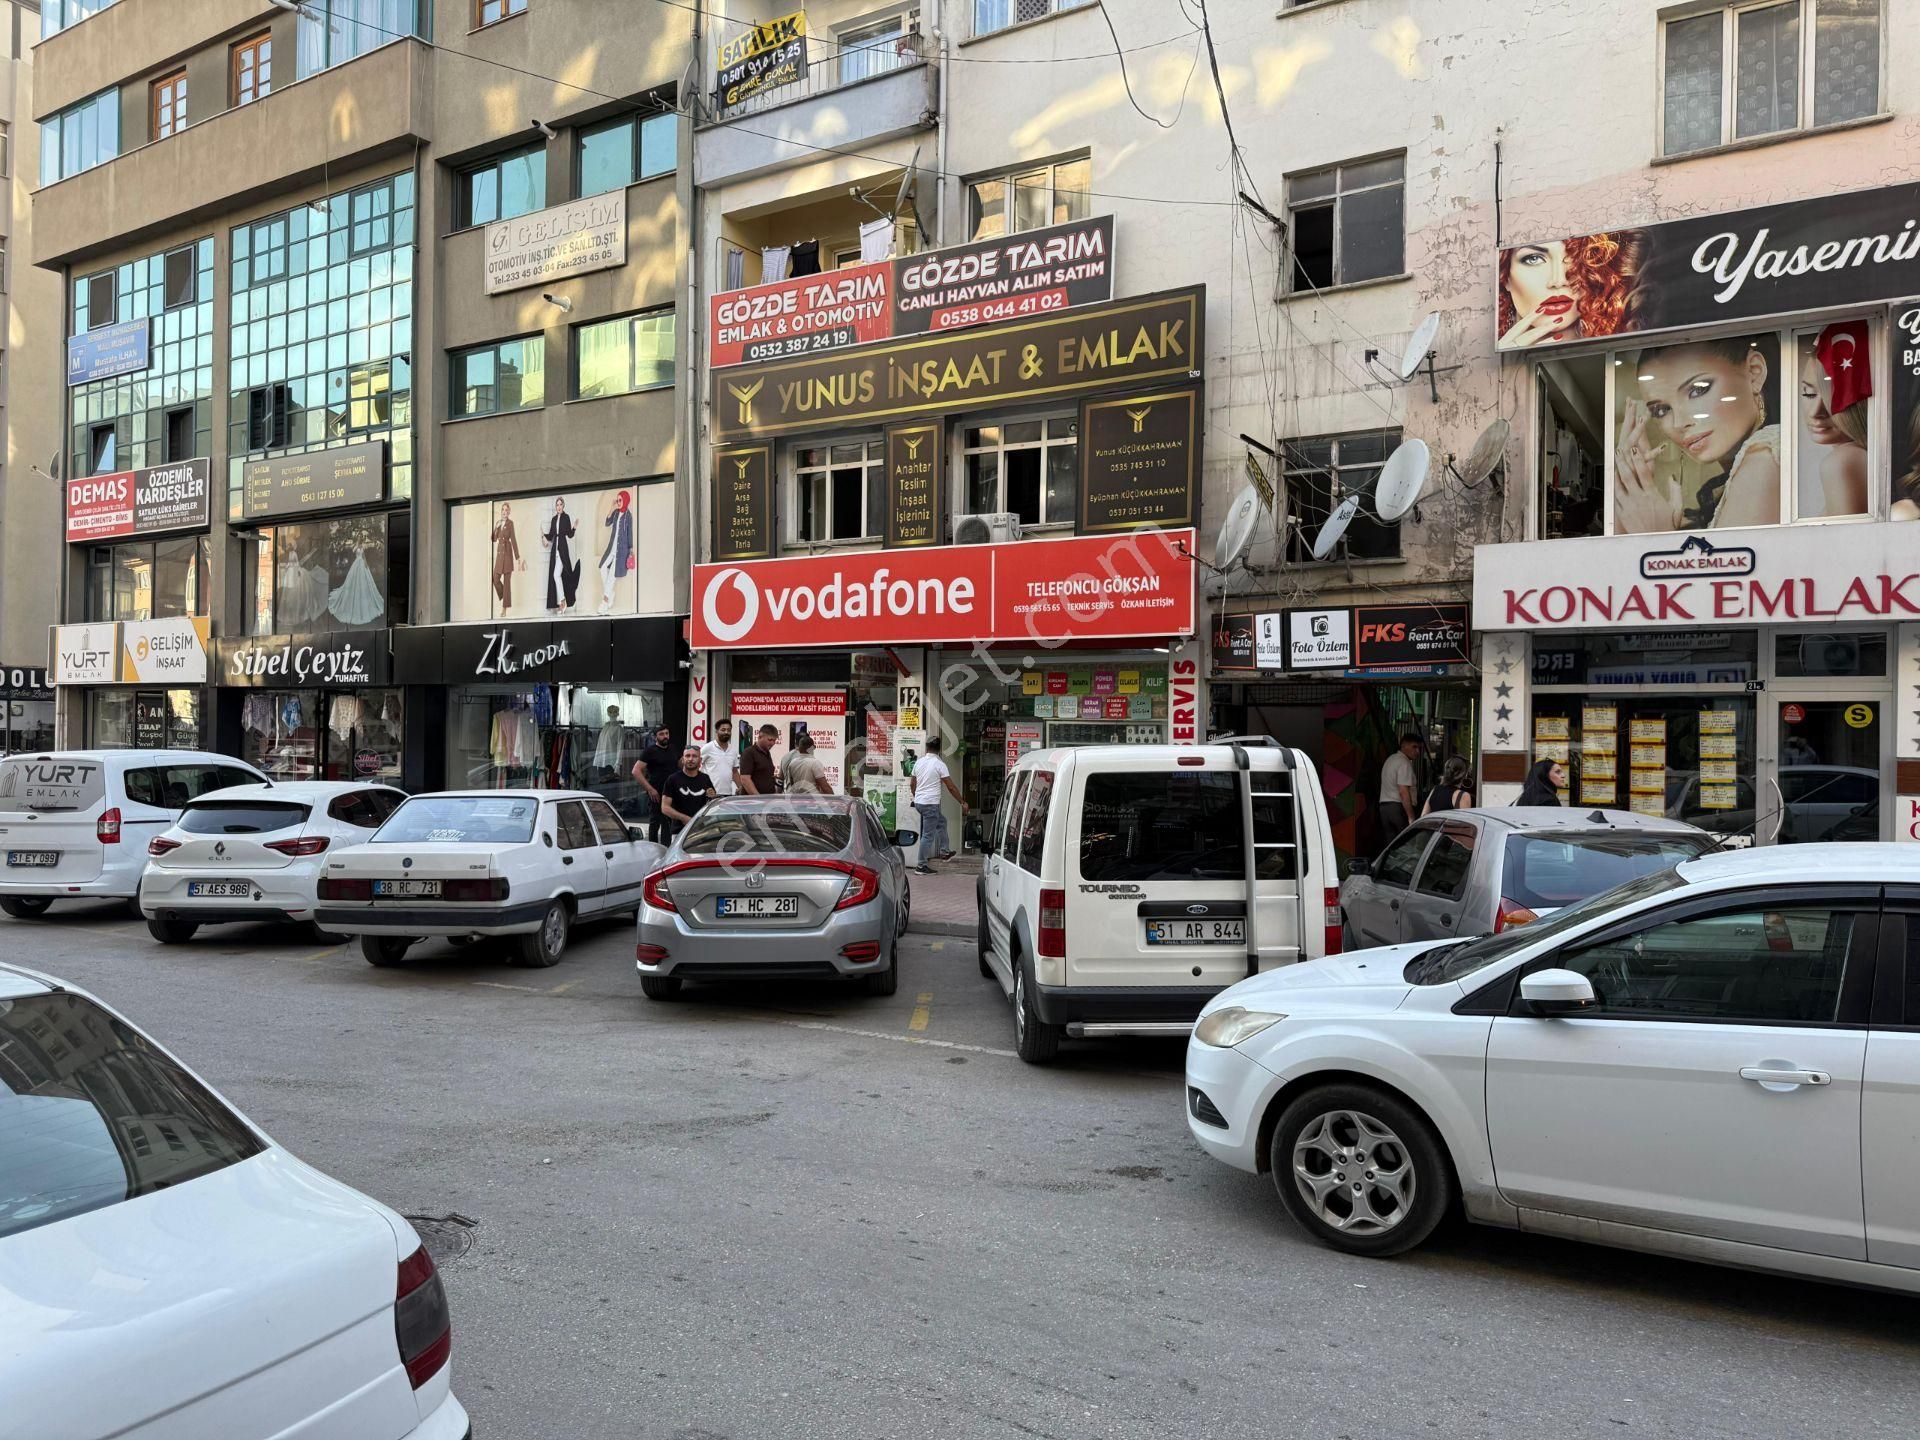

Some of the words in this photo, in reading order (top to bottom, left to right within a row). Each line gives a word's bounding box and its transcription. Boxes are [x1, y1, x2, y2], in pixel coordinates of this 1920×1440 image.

[721, 15, 798, 67] SATILIK
[721, 74, 728, 87] 0
[729, 65, 746, 83] 507
[787, 42, 801, 59] 25
[739, 73, 763, 93] EMRE
[517, 200, 619, 248] GELİŞİM
[488, 252, 528, 274] OTOMOTİV
[521, 268, 532, 280] 45
[588, 252, 600, 263] 45
[601, 249, 612, 260] 05
[902, 249, 997, 292] GÖZDE
[1004, 228, 1105, 270] TARIM
[900, 291, 944, 313] CANLI
[946, 279, 1009, 307] HAYVAN
[1011, 271, 1052, 292] ALIM
[1054, 259, 1105, 286] SATIM
[717, 287, 799, 326] GÖZDE
[801, 271, 886, 317] TARIM
[940, 307, 978, 327] 0538
[982, 302, 1015, 321] 044
[1018, 297, 1037, 313] 41
[1040, 292, 1063, 310] 02
[717, 317, 773, 346] EMLAK
[775, 318, 788, 335] &
[791, 299, 884, 331] OTOMOTİV
[749, 341, 782, 359] 0532
[785, 337, 810, 353] 387
[812, 334, 831, 350] 24
[832, 331, 848, 346] 19
[777, 369, 875, 415] YUNUS
[886, 348, 1007, 400] İNŞAAT
[1018, 343, 1043, 380] &
[1057, 319, 1185, 377] EMLAK
[895, 462, 932, 475] Anahtar
[1110, 463, 1128, 472] 0535
[1145, 460, 1154, 469] 51
[1156, 458, 1166, 468] 10
[149, 465, 193, 488] ÖZDEMİR
[900, 478, 927, 491] Teslim
[71, 478, 128, 506] DEMAŞ
[136, 479, 204, 505] KARDEŞLER
[336, 488, 345, 498] 00
[733, 482, 751, 491] Daire
[734, 493, 751, 502] Arsa
[899, 492, 927, 507] İnşaat
[736, 503, 749, 515] Bağ
[896, 507, 930, 524] İşleriniz
[899, 525, 927, 538] Yapılır
[1647, 558, 1696, 571] KONAK
[1698, 556, 1748, 570] EMLAK
[766, 568, 975, 621] vodafone
[1027, 579, 1100, 597] TELEFONCU
[1103, 574, 1160, 594] GÖKŞAN
[1042, 603, 1051, 612] 65
[1051, 603, 1061, 612] 65
[1067, 601, 1090, 611] TEKNİK
[1091, 600, 1114, 611] SERVİS
[1121, 599, 1145, 609] ÖZKAN
[1145, 597, 1174, 608] İLETİŞİM
[1503, 583, 1696, 624] KONAK
[1710, 574, 1920, 619] EMLAK
[1214, 630, 1230, 648] FKS
[1361, 623, 1406, 643] FKS
[1408, 630, 1434, 642] Rent
[1435, 631, 1444, 640] A
[1446, 630, 1465, 640] Car
[151, 632, 193, 654] GELİŞİM
[1291, 641, 1314, 654] Foto
[1316, 637, 1349, 653] Özlem
[61, 651, 110, 668] YURT
[155, 656, 186, 670] İNŞAAT
[231, 646, 291, 676] Sibel
[294, 643, 364, 684] Çeyiz
[522, 640, 569, 670] MODA
[1145, 677, 1164, 687] KILIF
[902, 687, 918, 708] 12
[787, 704, 796, 712] AY
[1851, 707, 1867, 722] S
[24, 764, 97, 784] YURT
[26, 788, 81, 798] EMLAK
[13, 854, 22, 863] 51
[25, 854, 38, 863] EY
[40, 854, 55, 863] 099
[194, 885, 204, 894] 51
[208, 884, 226, 895] AES
[229, 884, 247, 895] 986
[381, 881, 393, 893] 38
[399, 881, 411, 894] RC
[421, 881, 438, 893] 731
[1078, 884, 1140, 893] TOURNEO
[724, 898, 737, 913] 51
[748, 898, 764, 913] HC
[775, 898, 796, 913] 281
[1157, 923, 1173, 938] 51
[1185, 923, 1203, 938] AR
[1213, 923, 1241, 938] 844
